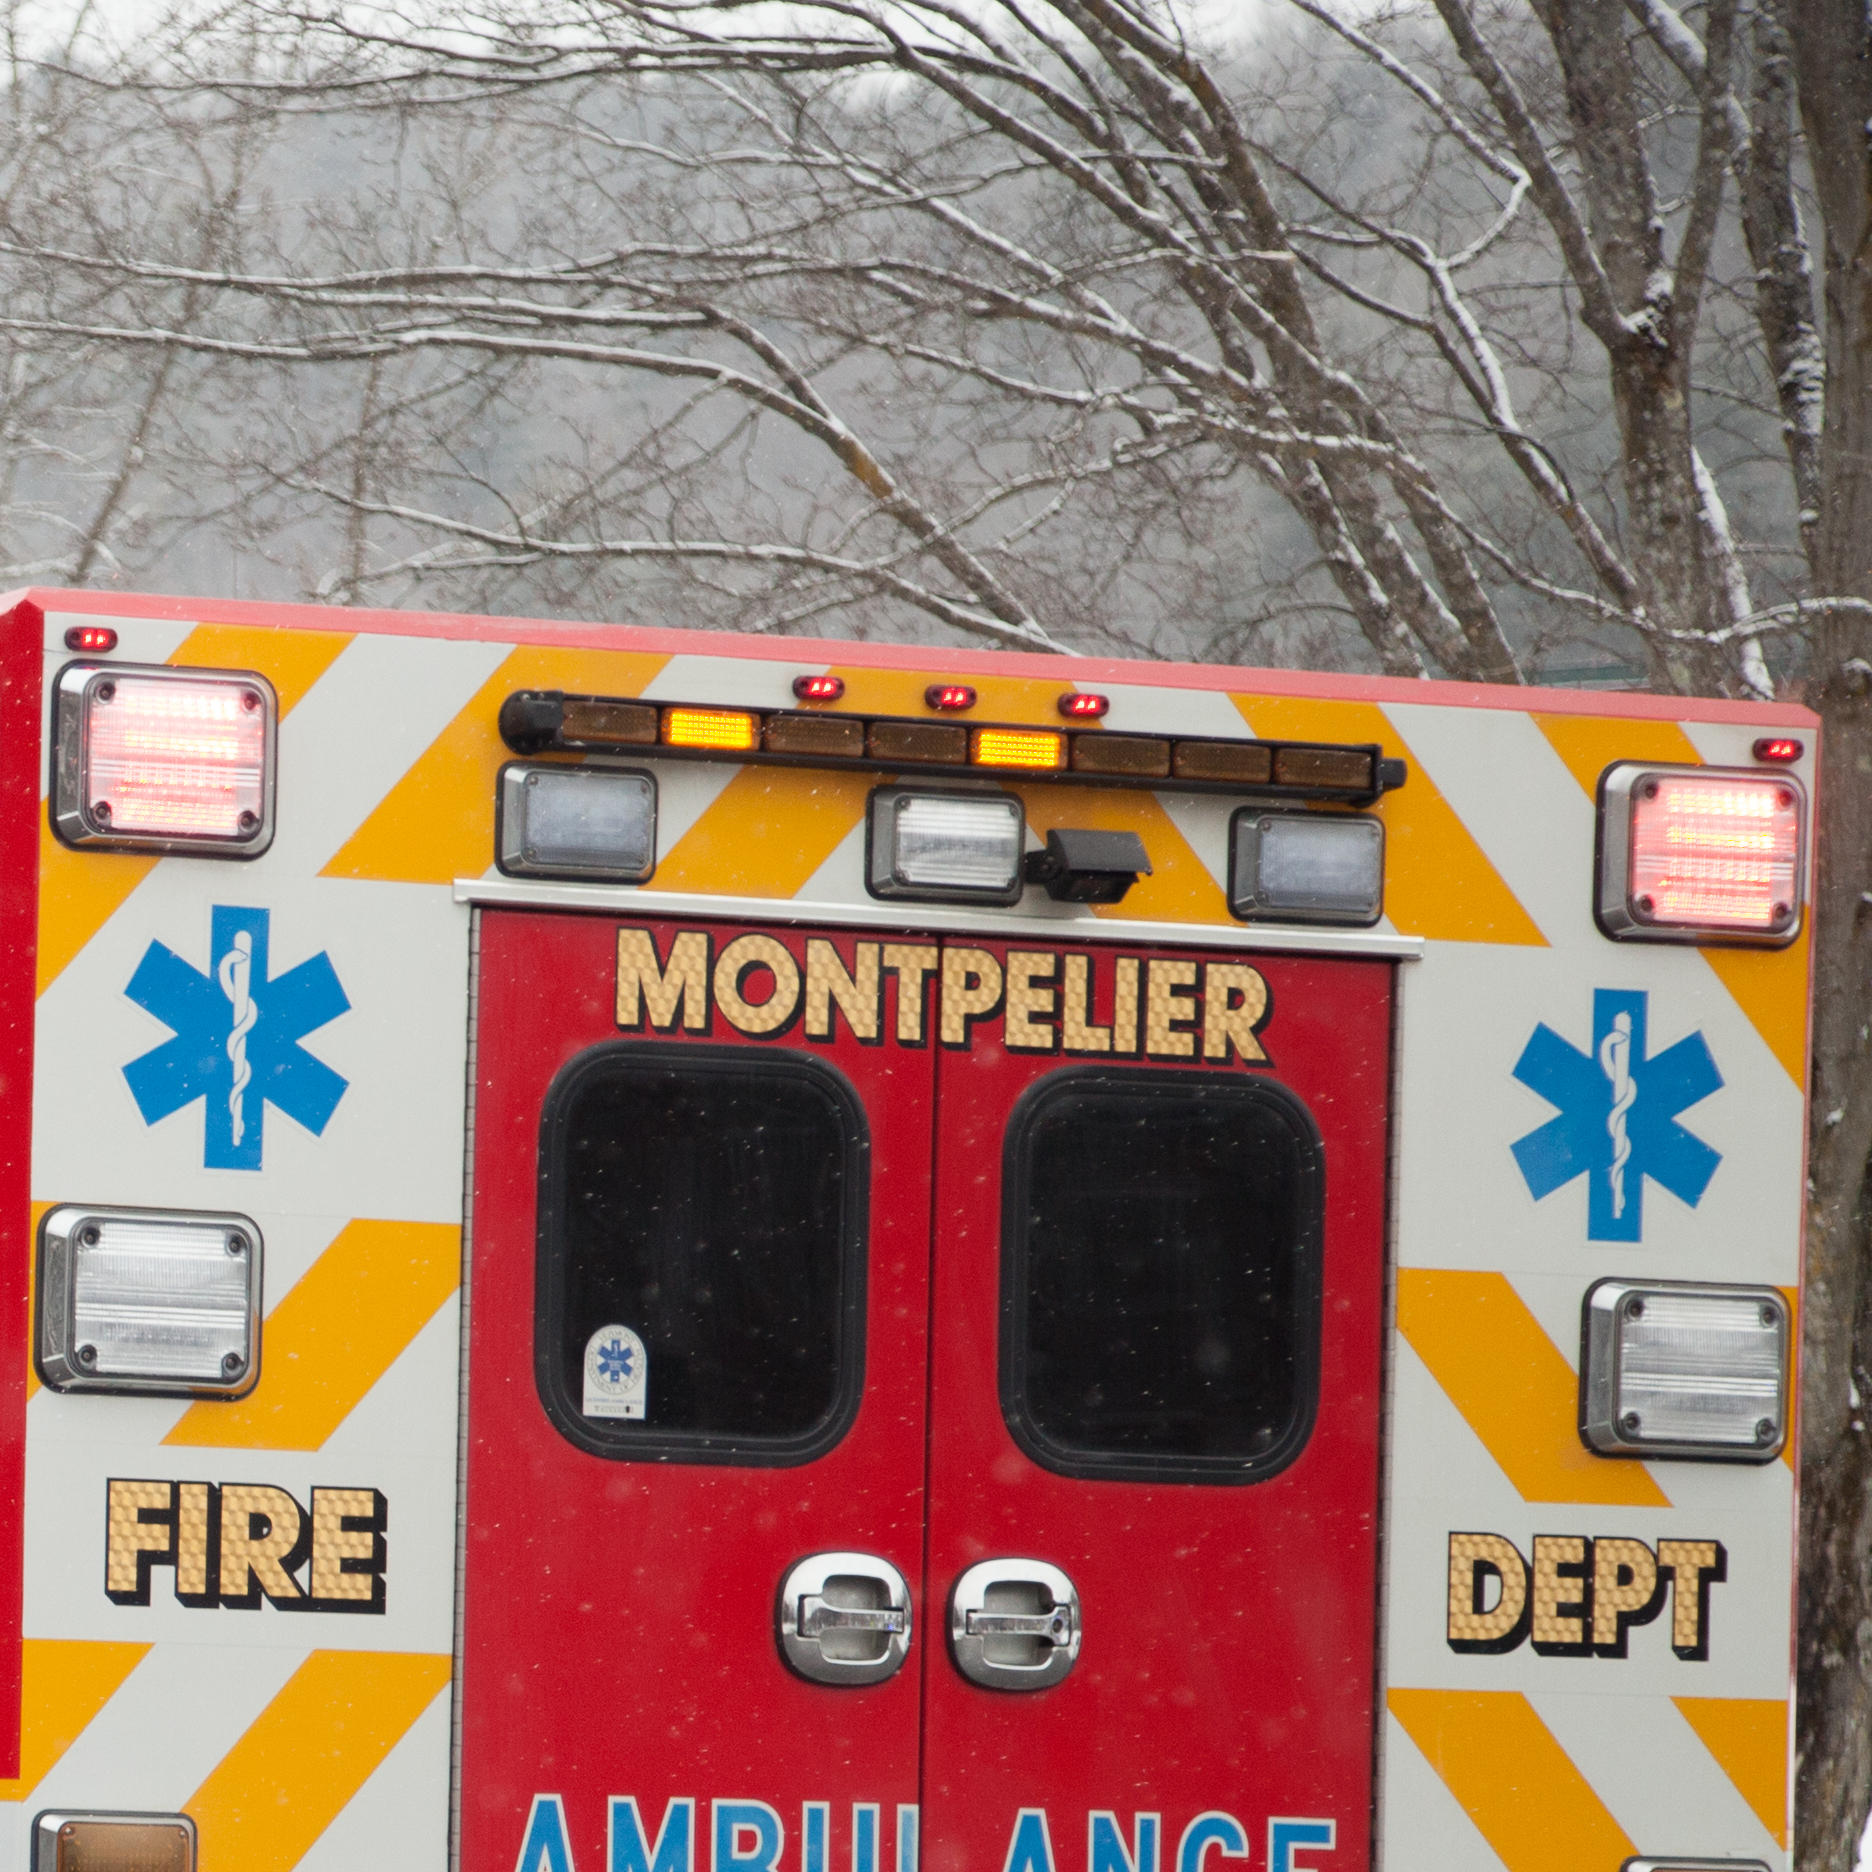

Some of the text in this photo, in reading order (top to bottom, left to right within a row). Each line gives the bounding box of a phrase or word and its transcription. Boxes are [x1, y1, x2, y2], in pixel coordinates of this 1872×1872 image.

[615, 927, 1276, 1069] MONTPELIER
[105, 1477, 388, 1615] FIRE
[1447, 1531, 1728, 1661] DEPT
